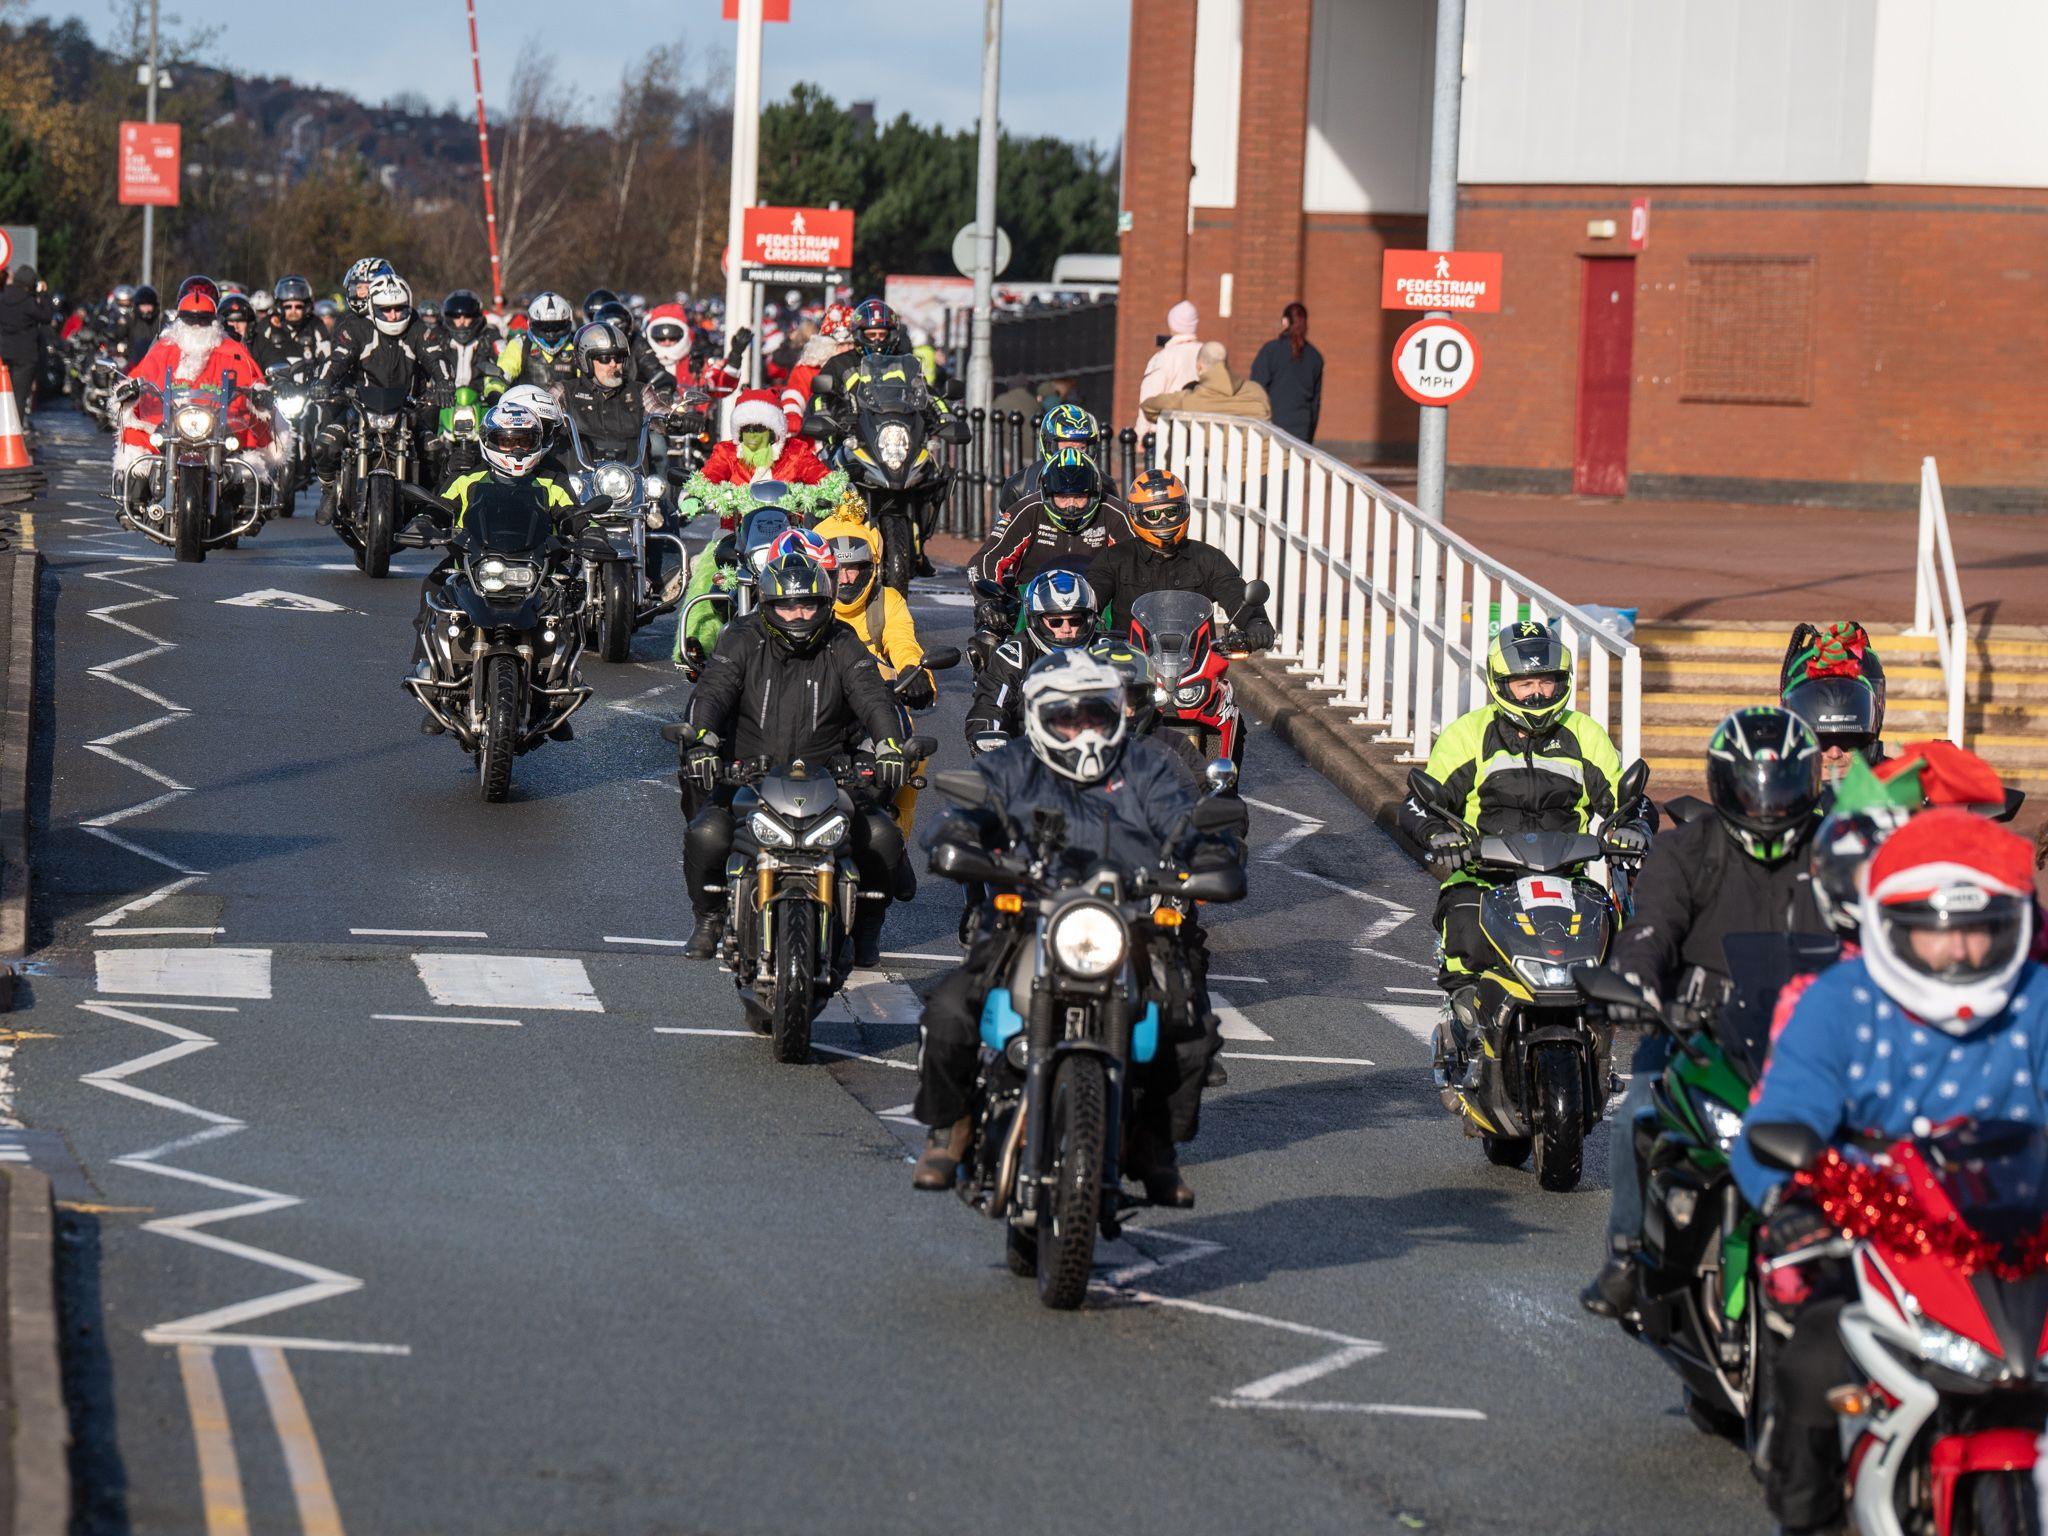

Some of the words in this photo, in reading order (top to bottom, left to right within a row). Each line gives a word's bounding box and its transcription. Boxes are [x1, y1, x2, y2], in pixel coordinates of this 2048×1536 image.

[756, 233, 839, 249] PEDESTRIAN
[764, 247, 830, 263] CROSSING
[748, 271, 772, 281] MAIN
[774, 271, 823, 282] RECEPTION
[1396, 278, 1486, 295] PEDESTRIAN
[1405, 292, 1475, 308] CROSSING
[1415, 338, 1463, 373] 10
[1419, 375, 1453, 388] MPH
[1530, 881, 1562, 899] L
